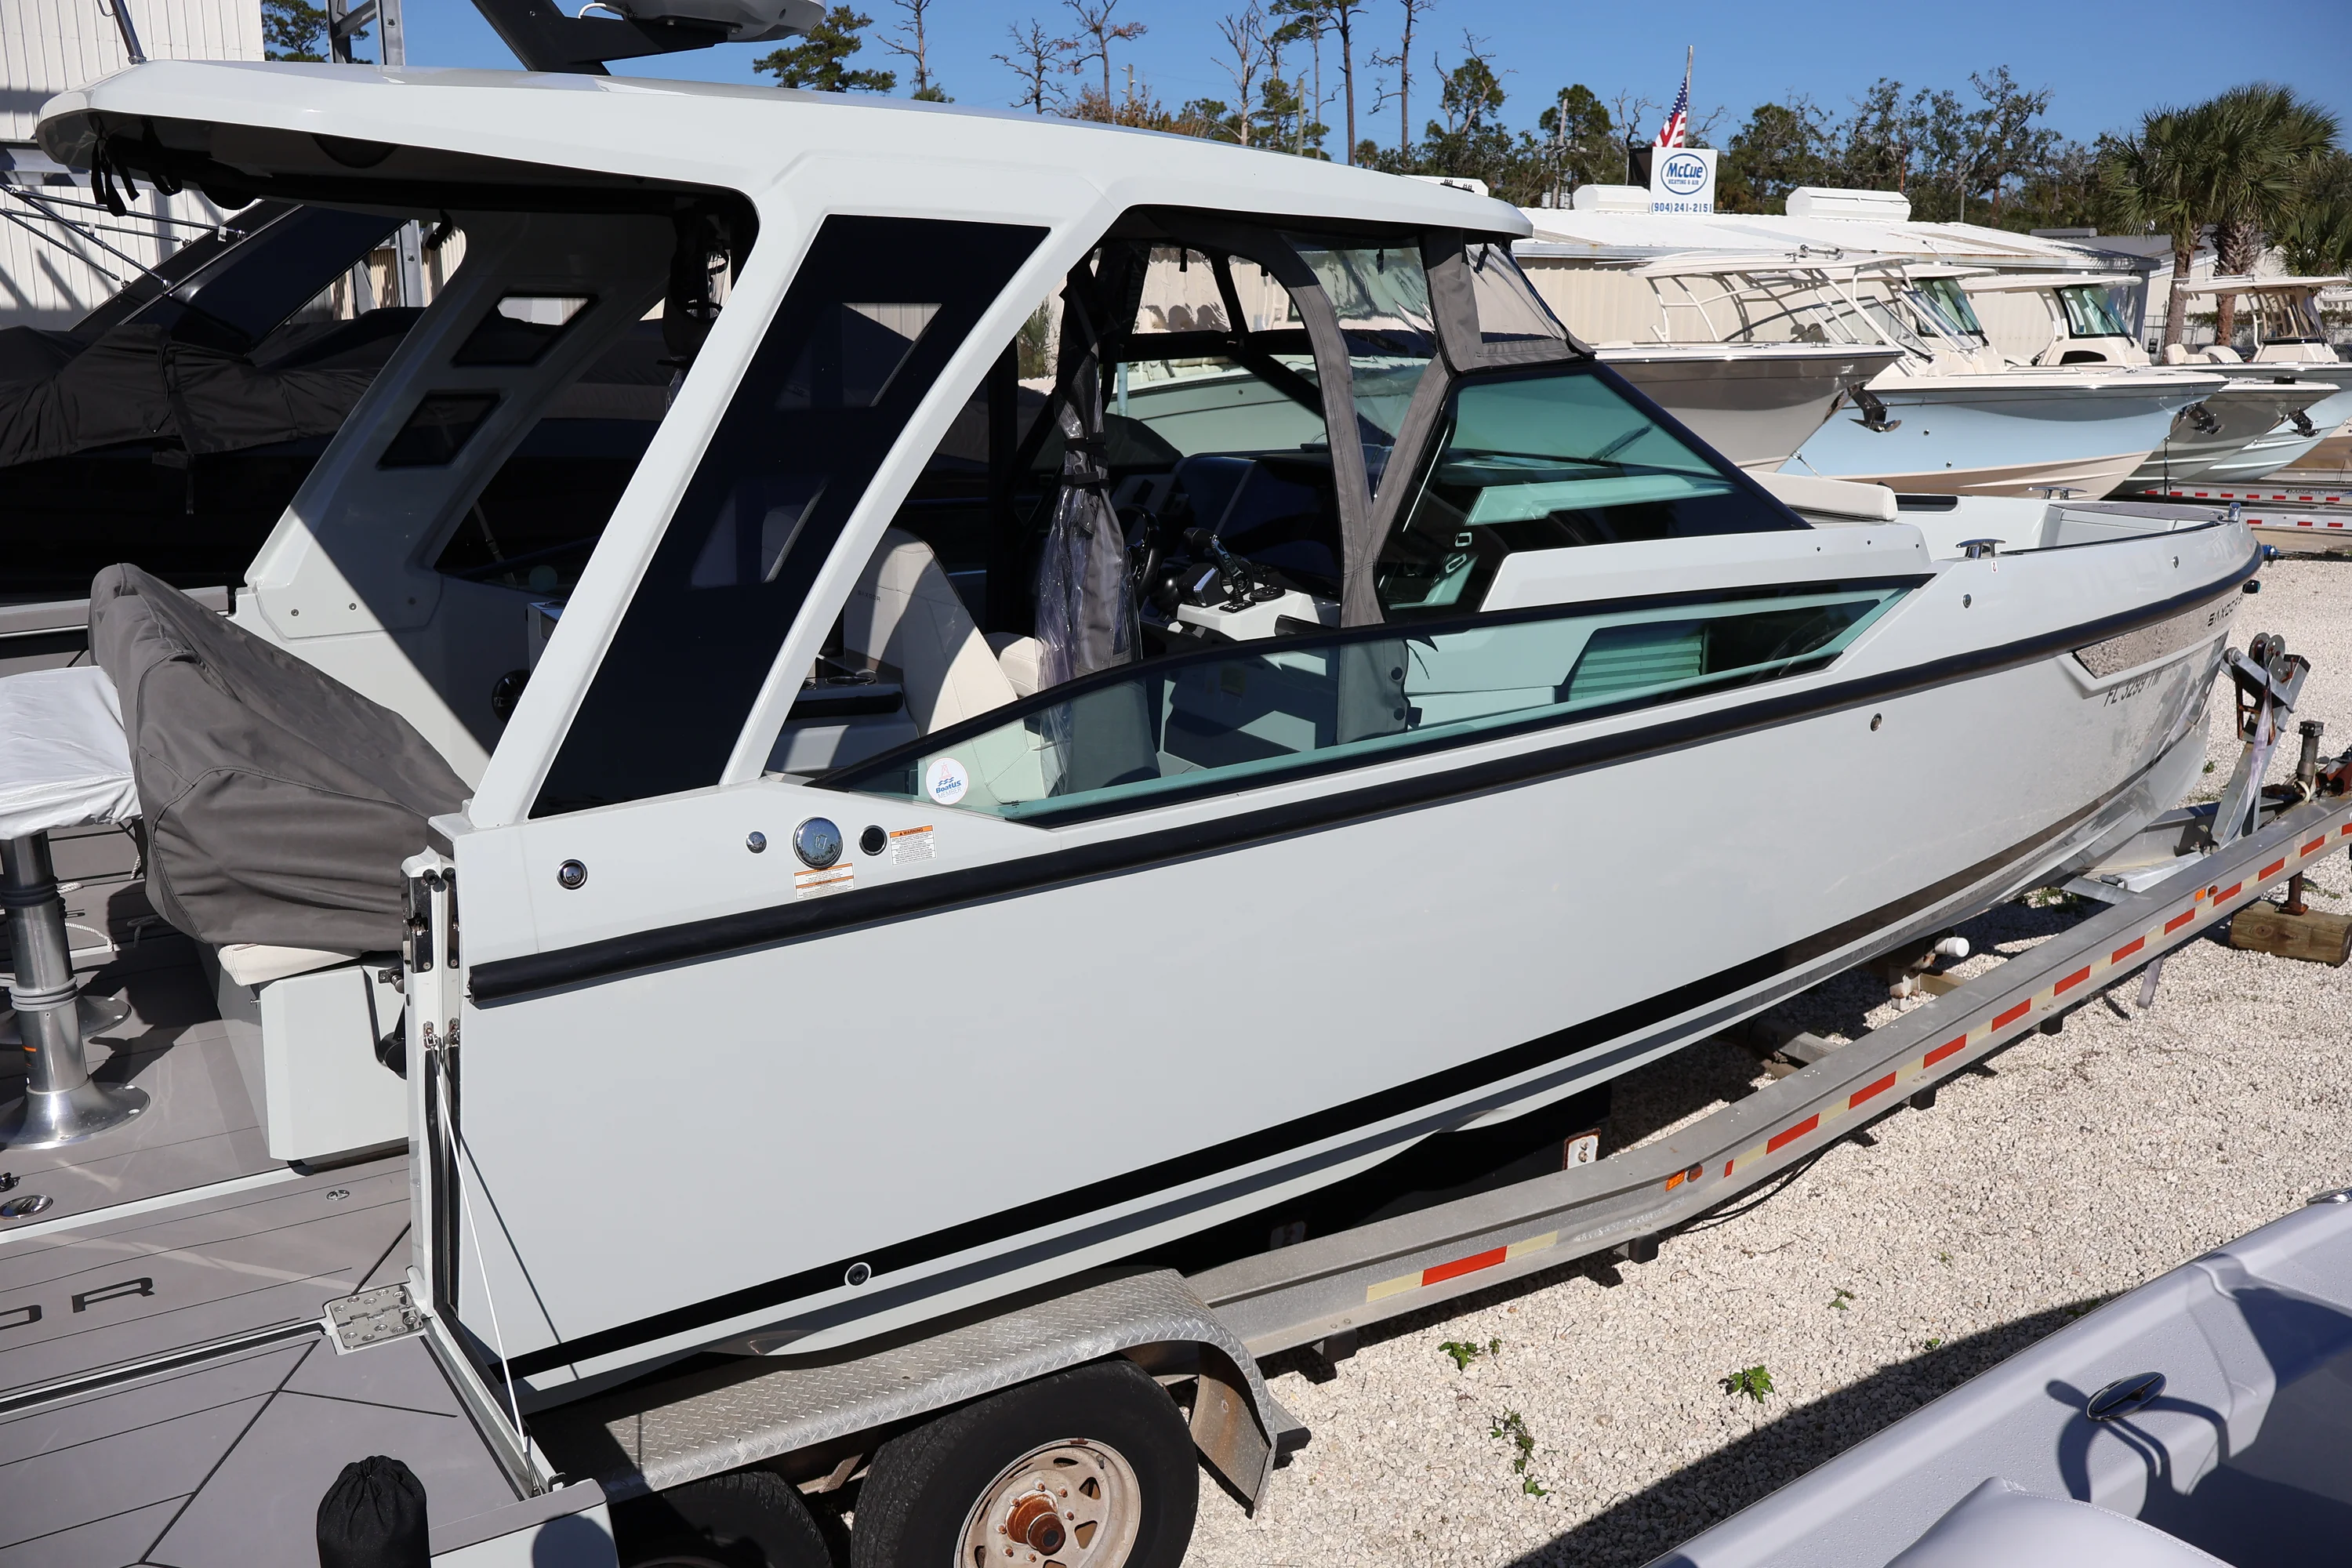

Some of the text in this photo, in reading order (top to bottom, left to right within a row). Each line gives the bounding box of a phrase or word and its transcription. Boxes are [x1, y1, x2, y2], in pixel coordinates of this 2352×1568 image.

[1667, 162, 1703, 178] McCue
[2103, 682, 2122, 707] FL
[935, 779, 962, 794] BoatUS
[938, 786, 963, 800] MEMBER
